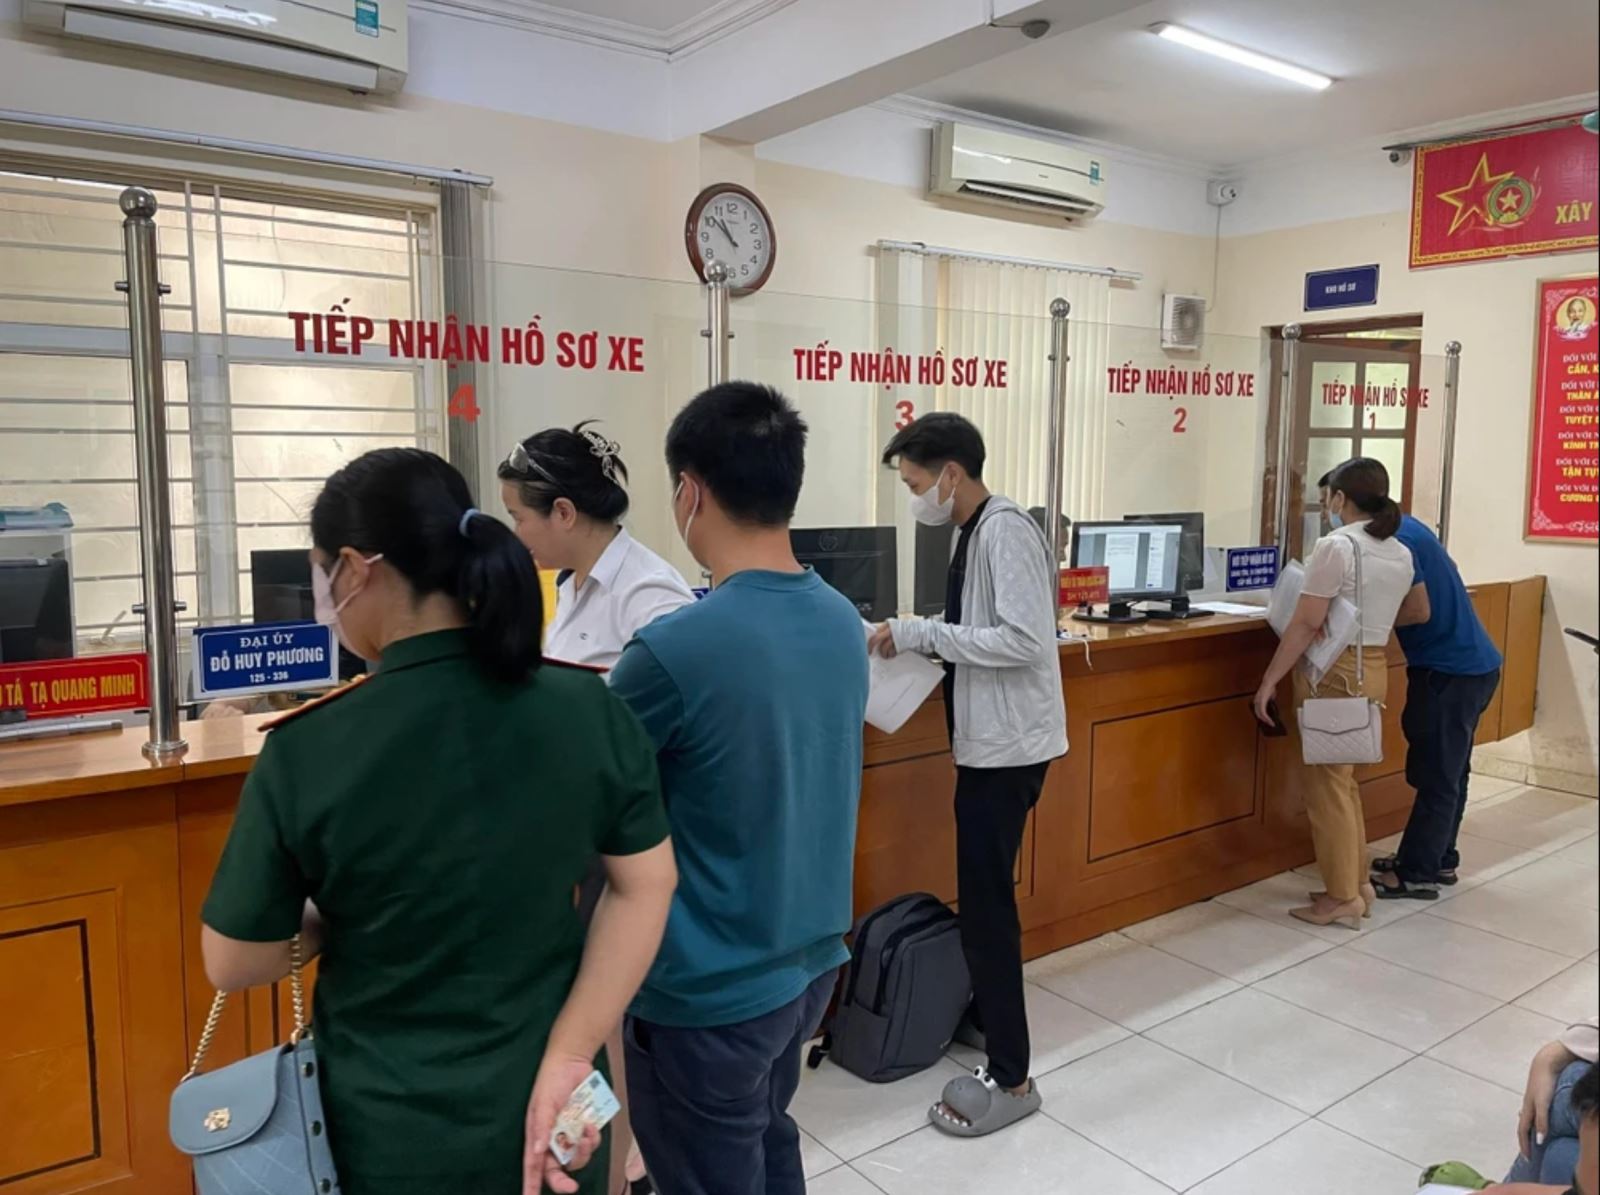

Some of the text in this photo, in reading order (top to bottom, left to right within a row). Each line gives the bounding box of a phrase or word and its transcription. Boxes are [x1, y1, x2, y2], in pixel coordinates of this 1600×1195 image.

[715, 206, 723, 216] 11
[727, 203, 738, 215] 12
[1555, 200, 1593, 224] XÂY
[701, 232, 709, 242] 9
[750, 223, 759, 235] 2
[706, 248, 714, 260] 8
[754, 240, 762, 250] 3
[741, 264, 749, 276] 5
[750, 255, 757, 264] 4
[288, 298, 645, 372] TIẾP NHẬN HỒ SƠ XE
[793, 340, 1007, 390] TIẾP NHẬN HỒ SƠ XE
[1107, 360, 1141, 393] TIẾP
[1146, 364, 1188, 400] NHẬN
[1215, 371, 1234, 397] SƠ
[1237, 373, 1254, 397] XE
[1322, 374, 1347, 405] TIẾP
[448, 383, 481, 424] 4
[895, 400, 914, 432] 3
[1173, 407, 1187, 433] 2
[1369, 412, 1376, 434] 1
[240, 632, 294, 649] ĐẠI ÚY
[234, 651, 262, 670] HUY
[266, 647, 324, 667] PHƯƠNG
[250, 673, 265, 683] 125
[5, 678, 24, 706] TÁ
[30, 681, 48, 709] TẠ
[51, 676, 97, 704] QUANG
[100, 673, 135, 698] MINH
